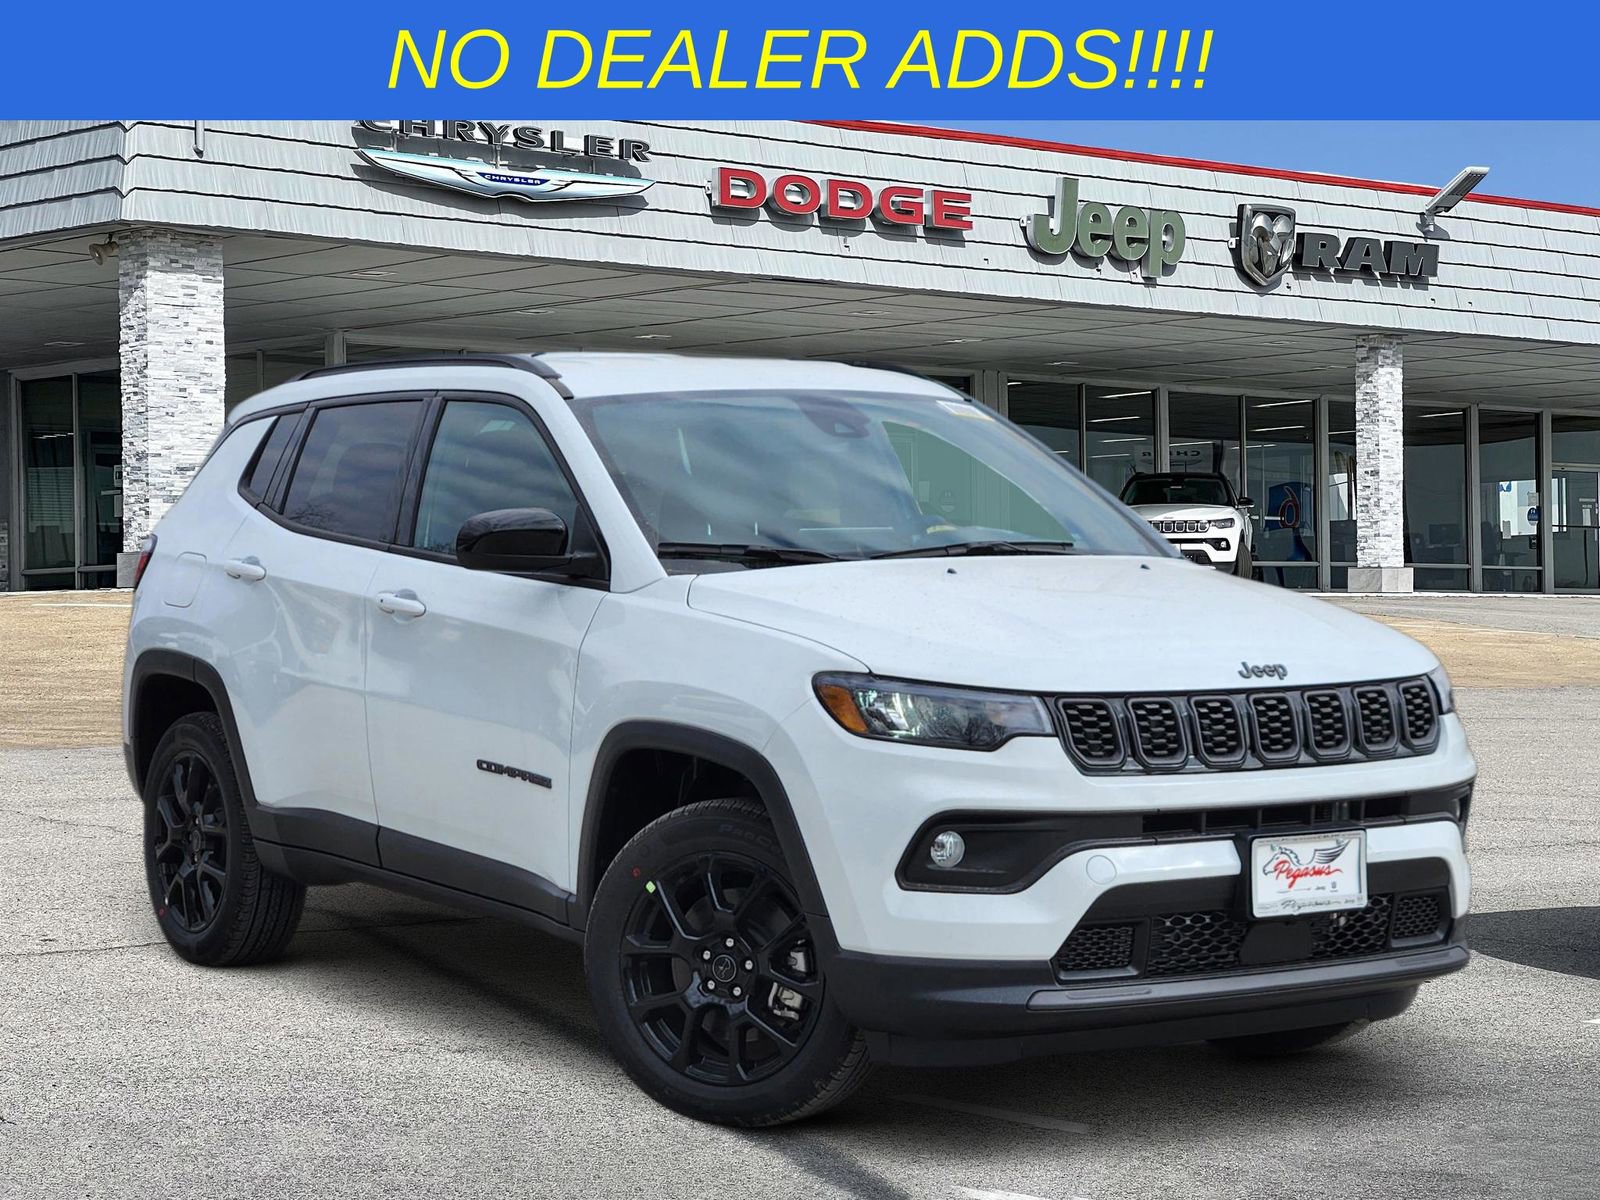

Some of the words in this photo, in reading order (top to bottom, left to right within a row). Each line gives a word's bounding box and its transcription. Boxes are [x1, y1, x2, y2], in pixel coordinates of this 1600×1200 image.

[484, 174, 541, 185] CHRYSLER
[713, 167, 973, 230] DODGE
[1027, 177, 1186, 279] Jeep
[1295, 232, 1440, 278] RAM
[1237, 661, 1289, 681] Jeep
[1273, 859, 1343, 890] Pegasus
